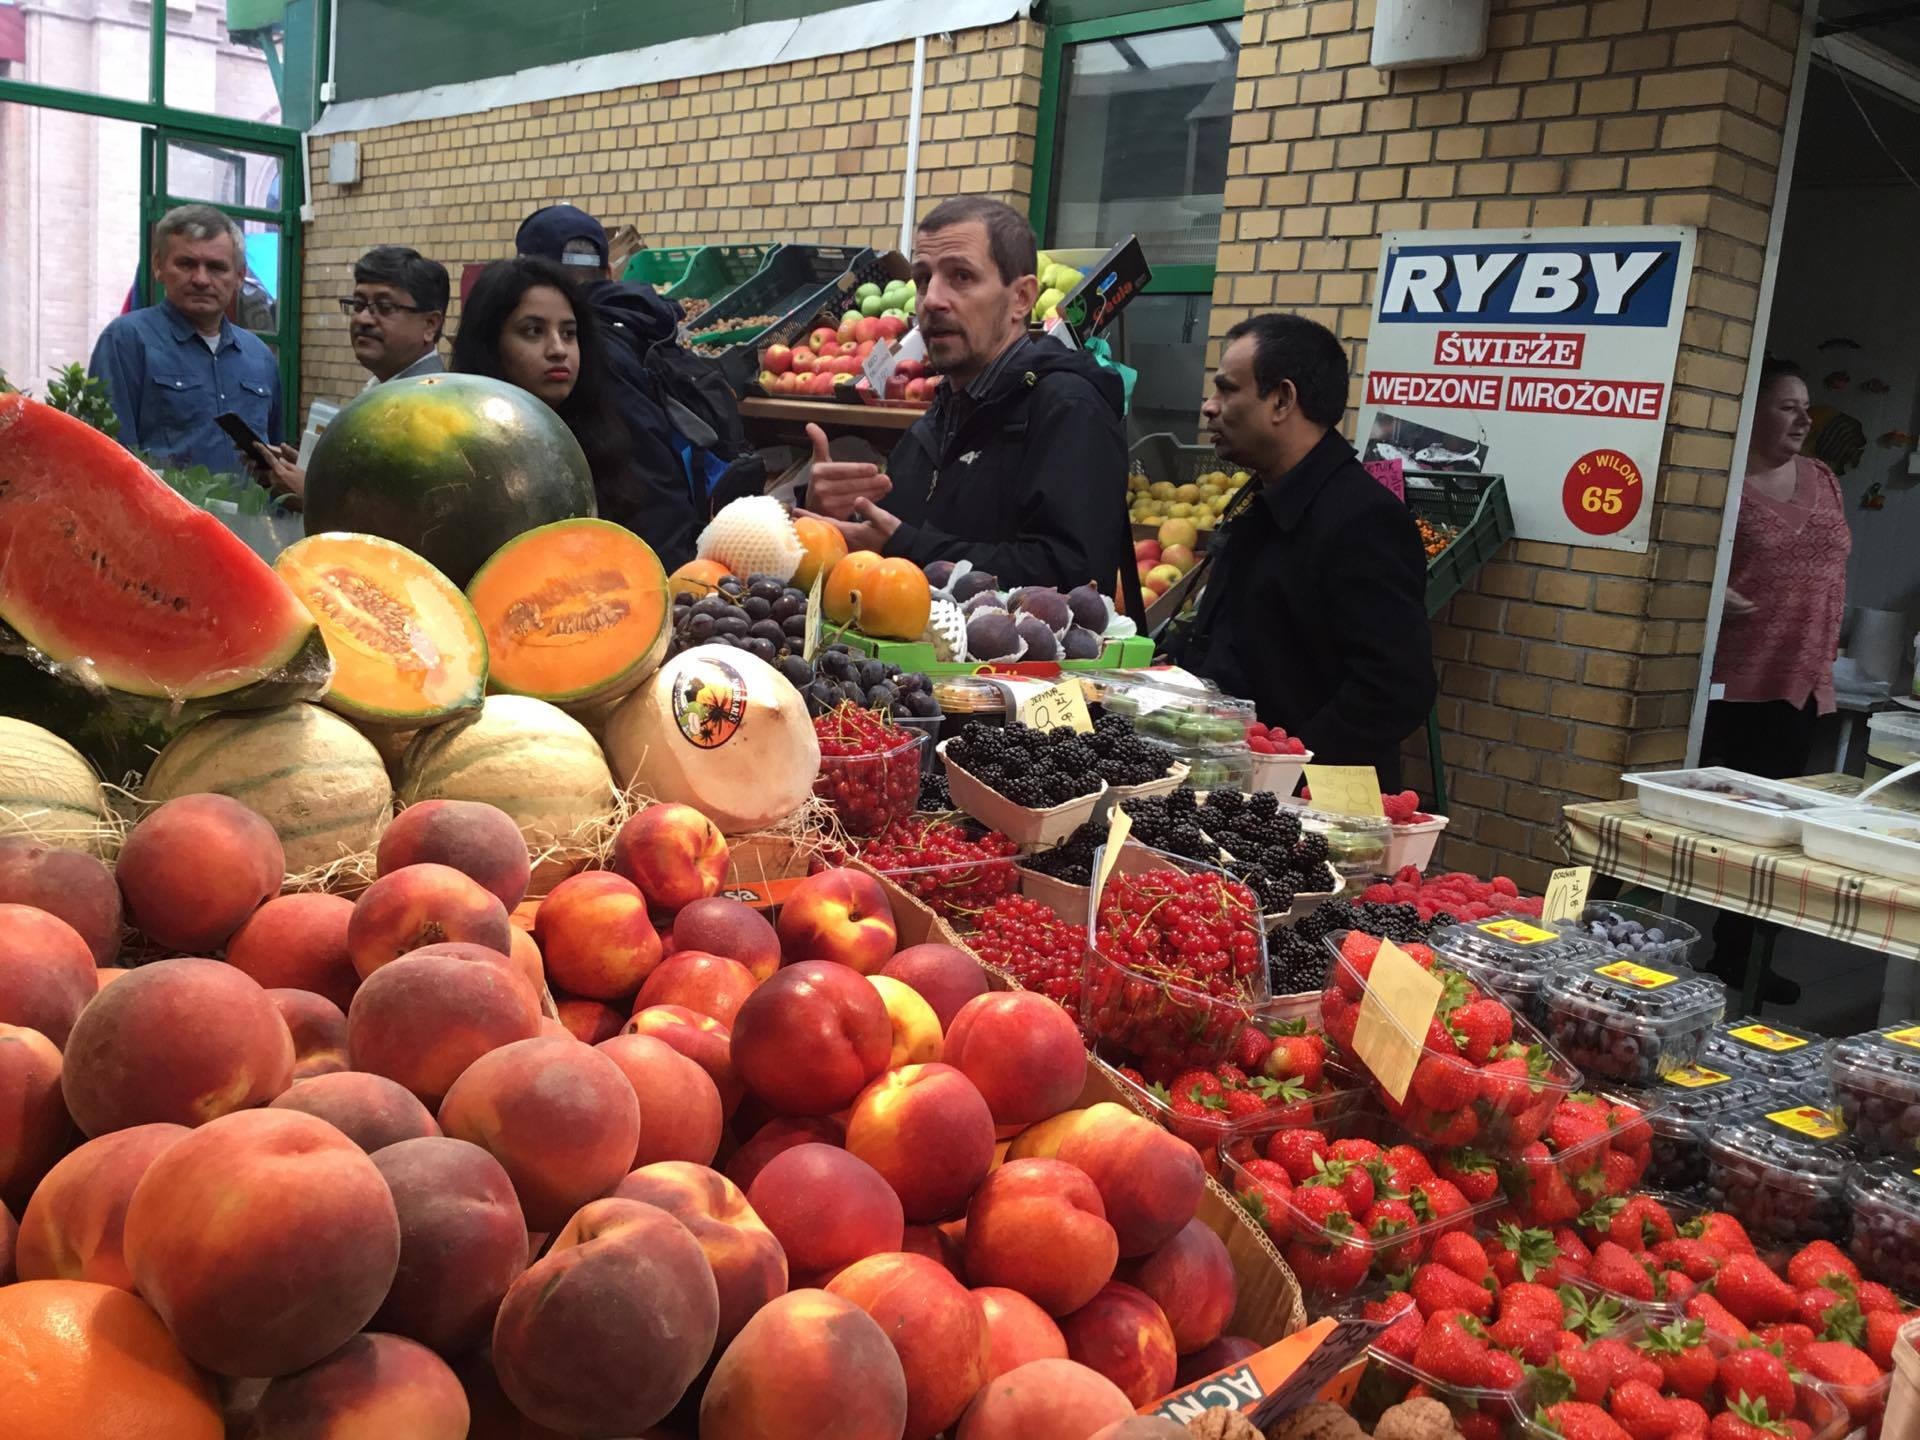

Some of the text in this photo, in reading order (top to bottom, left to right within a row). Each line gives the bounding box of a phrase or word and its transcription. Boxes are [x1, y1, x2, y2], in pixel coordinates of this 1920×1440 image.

[1381, 251, 1664, 315] RYBY
[1439, 332, 1578, 366] ŚWIEŻE
[1371, 376, 1659, 415] WĘDZONE MROŻONE
[1582, 486, 1623, 515] 65
